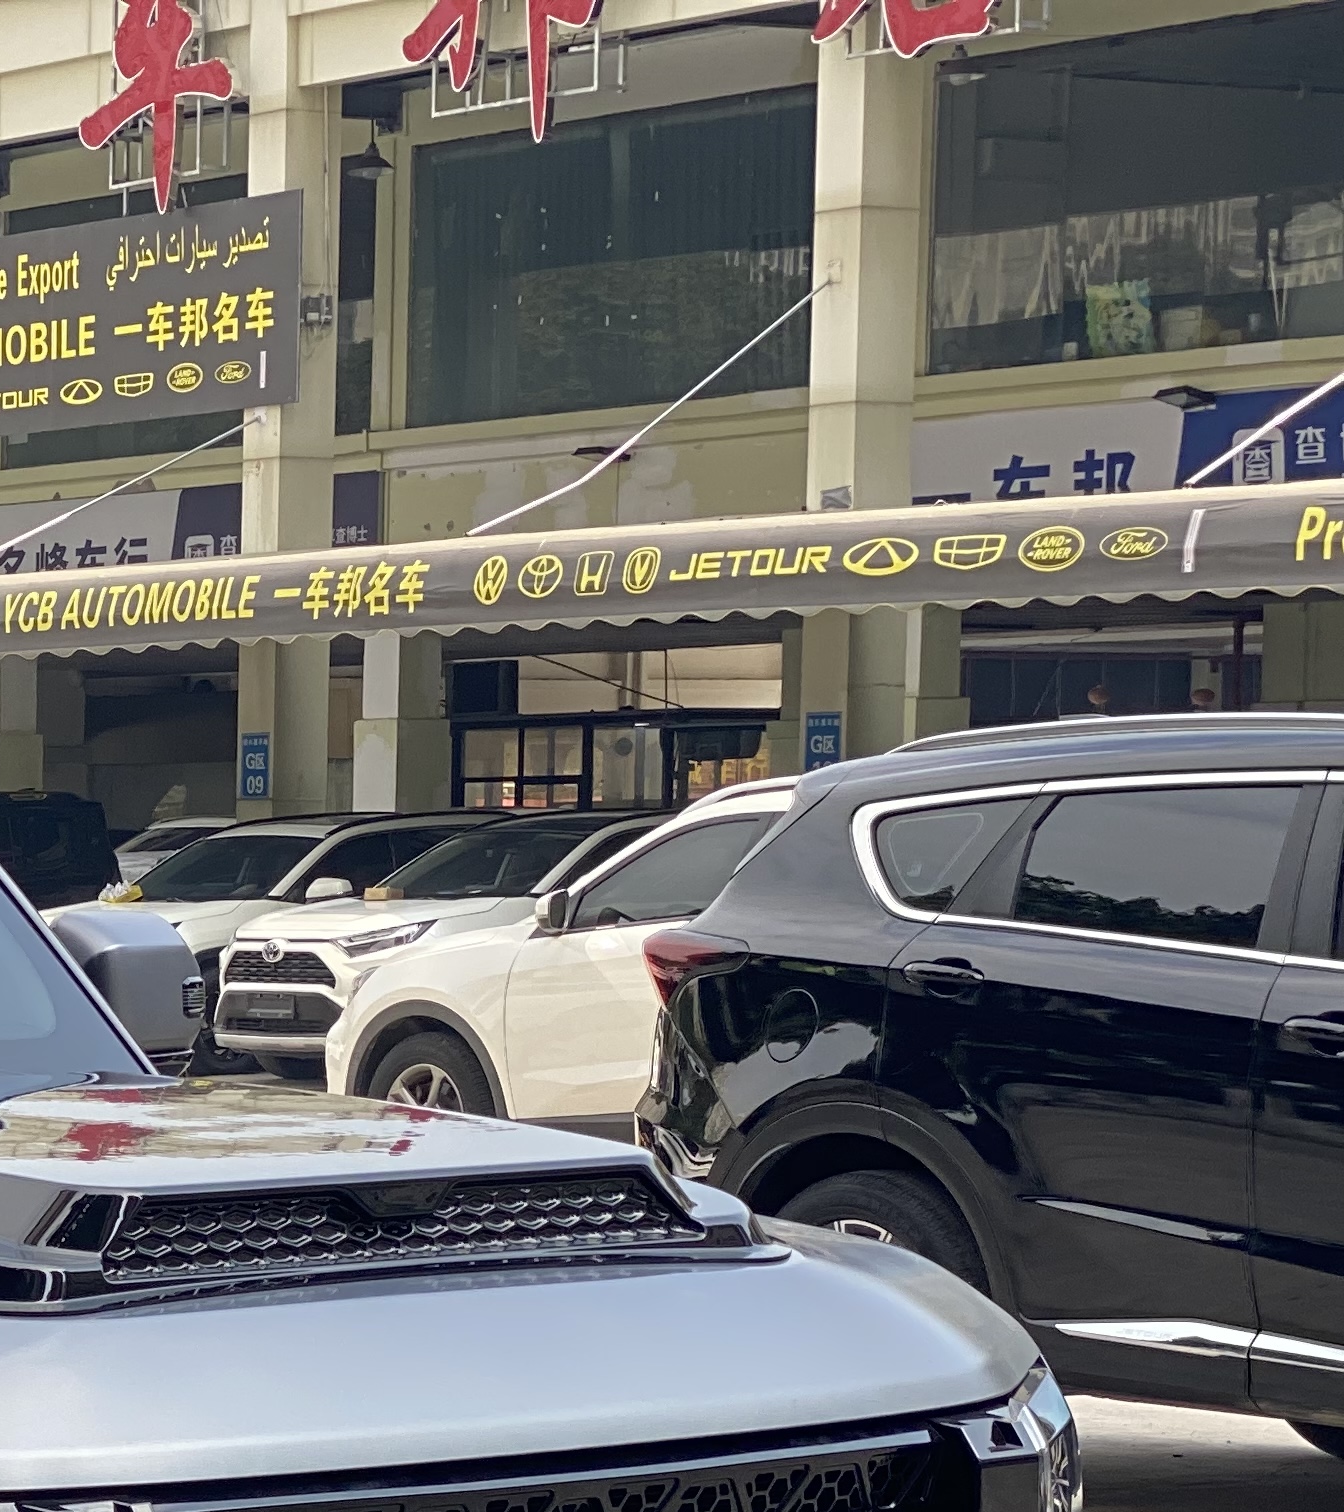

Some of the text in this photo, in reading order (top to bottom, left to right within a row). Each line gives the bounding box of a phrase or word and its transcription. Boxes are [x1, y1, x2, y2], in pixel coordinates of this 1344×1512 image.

[17, 251, 80, 303] Export
[113, 286, 275, 352] 一车邦名车
[220, 364, 245, 381] Ford
[332, 524, 369, 545] 查博士
[1110, 531, 1158, 555] Ford
[1295, 506, 1344, 561] Pr
[669, 545, 832, 582] JETOUR
[2, 575, 260, 634] YCB AUTOMOBILE
[272, 559, 431, 621] 一车邦名车
[246, 775, 264, 795] 09
